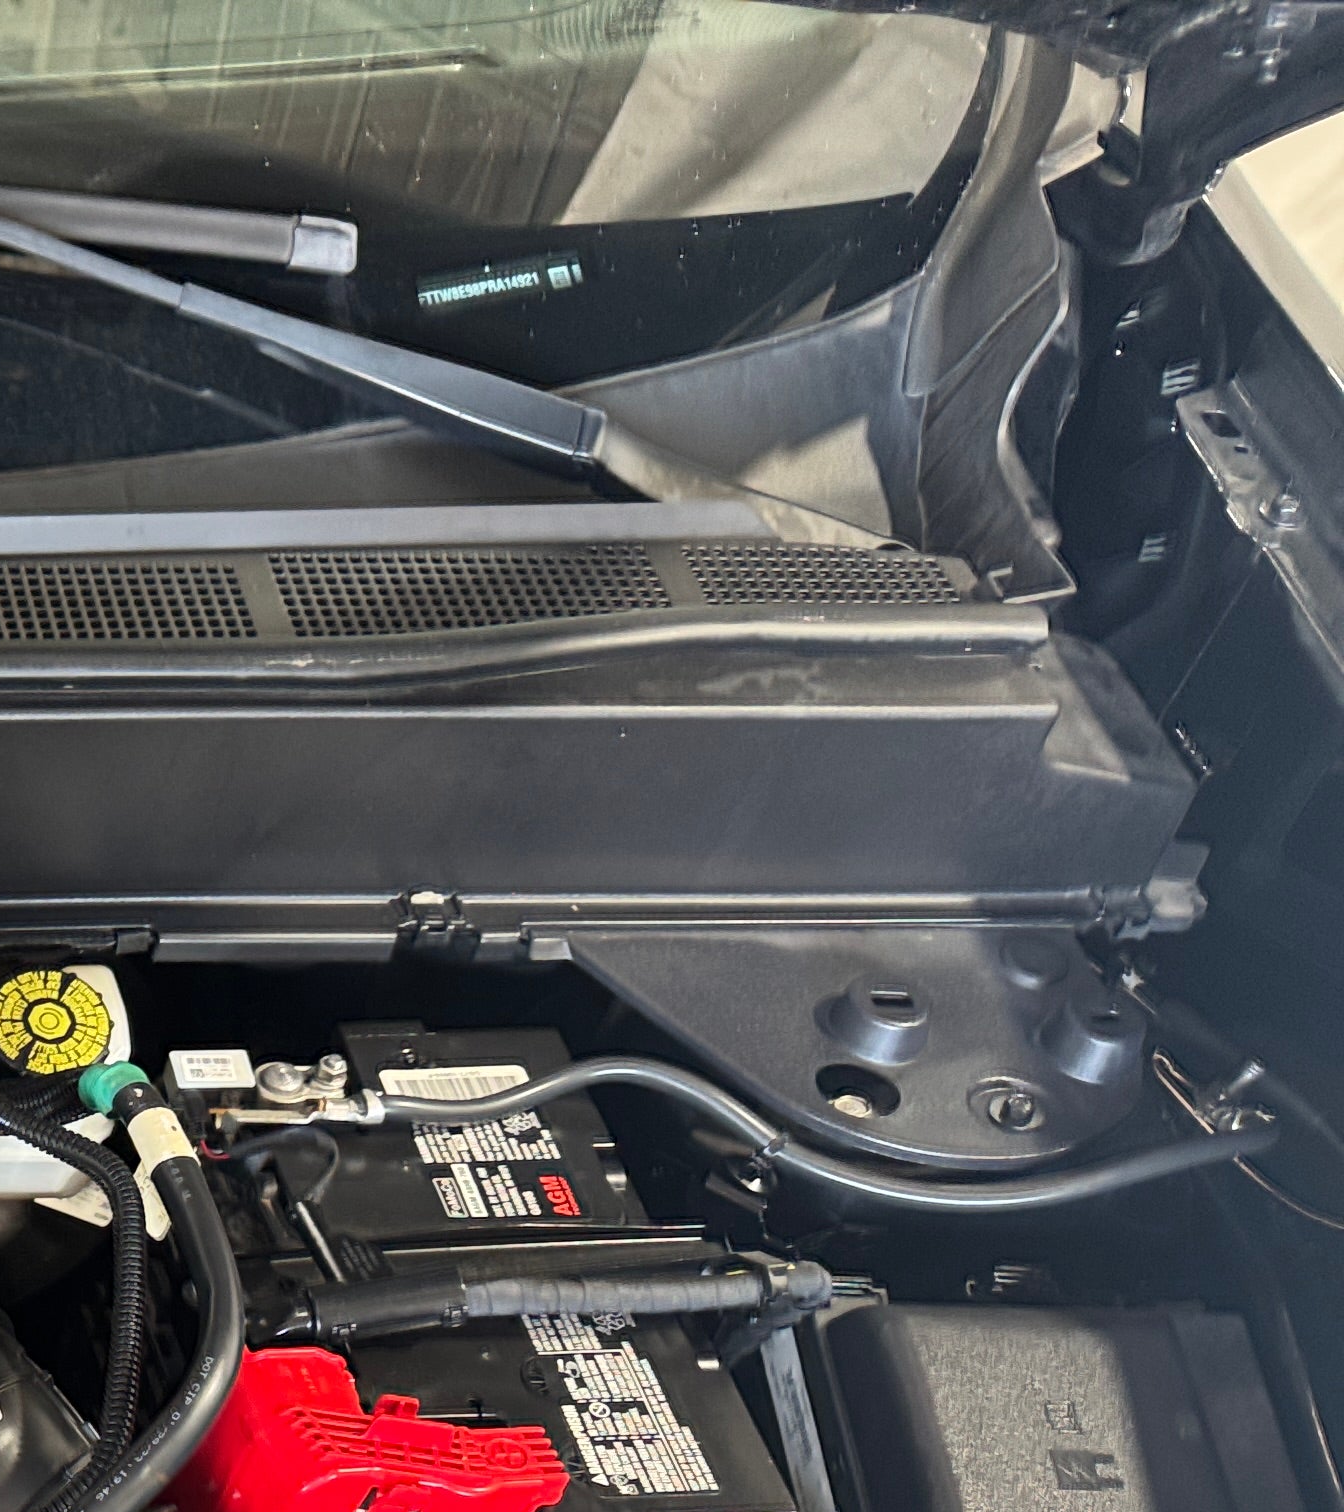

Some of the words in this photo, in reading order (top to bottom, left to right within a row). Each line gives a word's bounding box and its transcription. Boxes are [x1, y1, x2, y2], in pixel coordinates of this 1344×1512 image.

[539, 1175, 573, 1216] AGM
[200, 1356, 214, 1379] DOT
[184, 1383, 201, 1406] CIP
